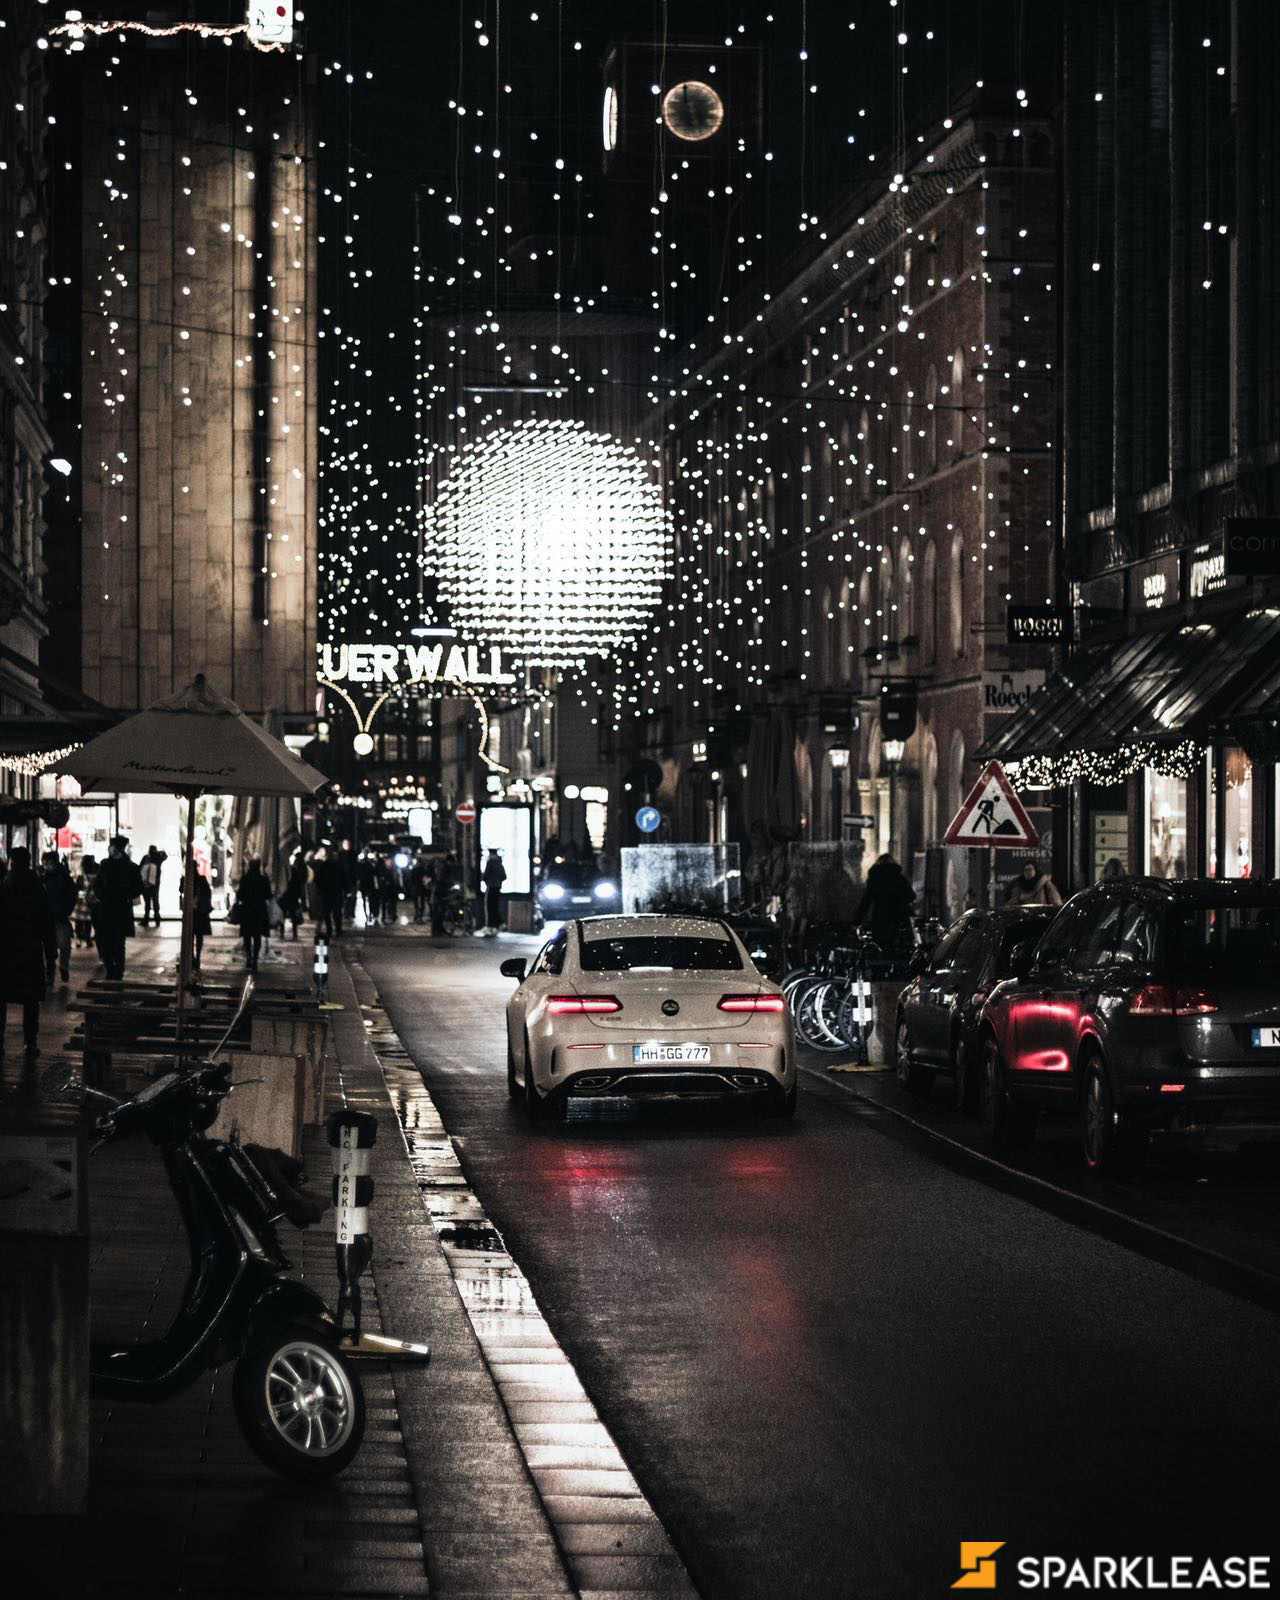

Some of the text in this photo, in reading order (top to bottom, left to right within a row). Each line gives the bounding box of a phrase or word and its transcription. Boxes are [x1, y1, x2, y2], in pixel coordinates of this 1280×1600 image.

[316, 643, 516, 684] UER WALL
[641, 1047, 709, 1060] HH GG 777
